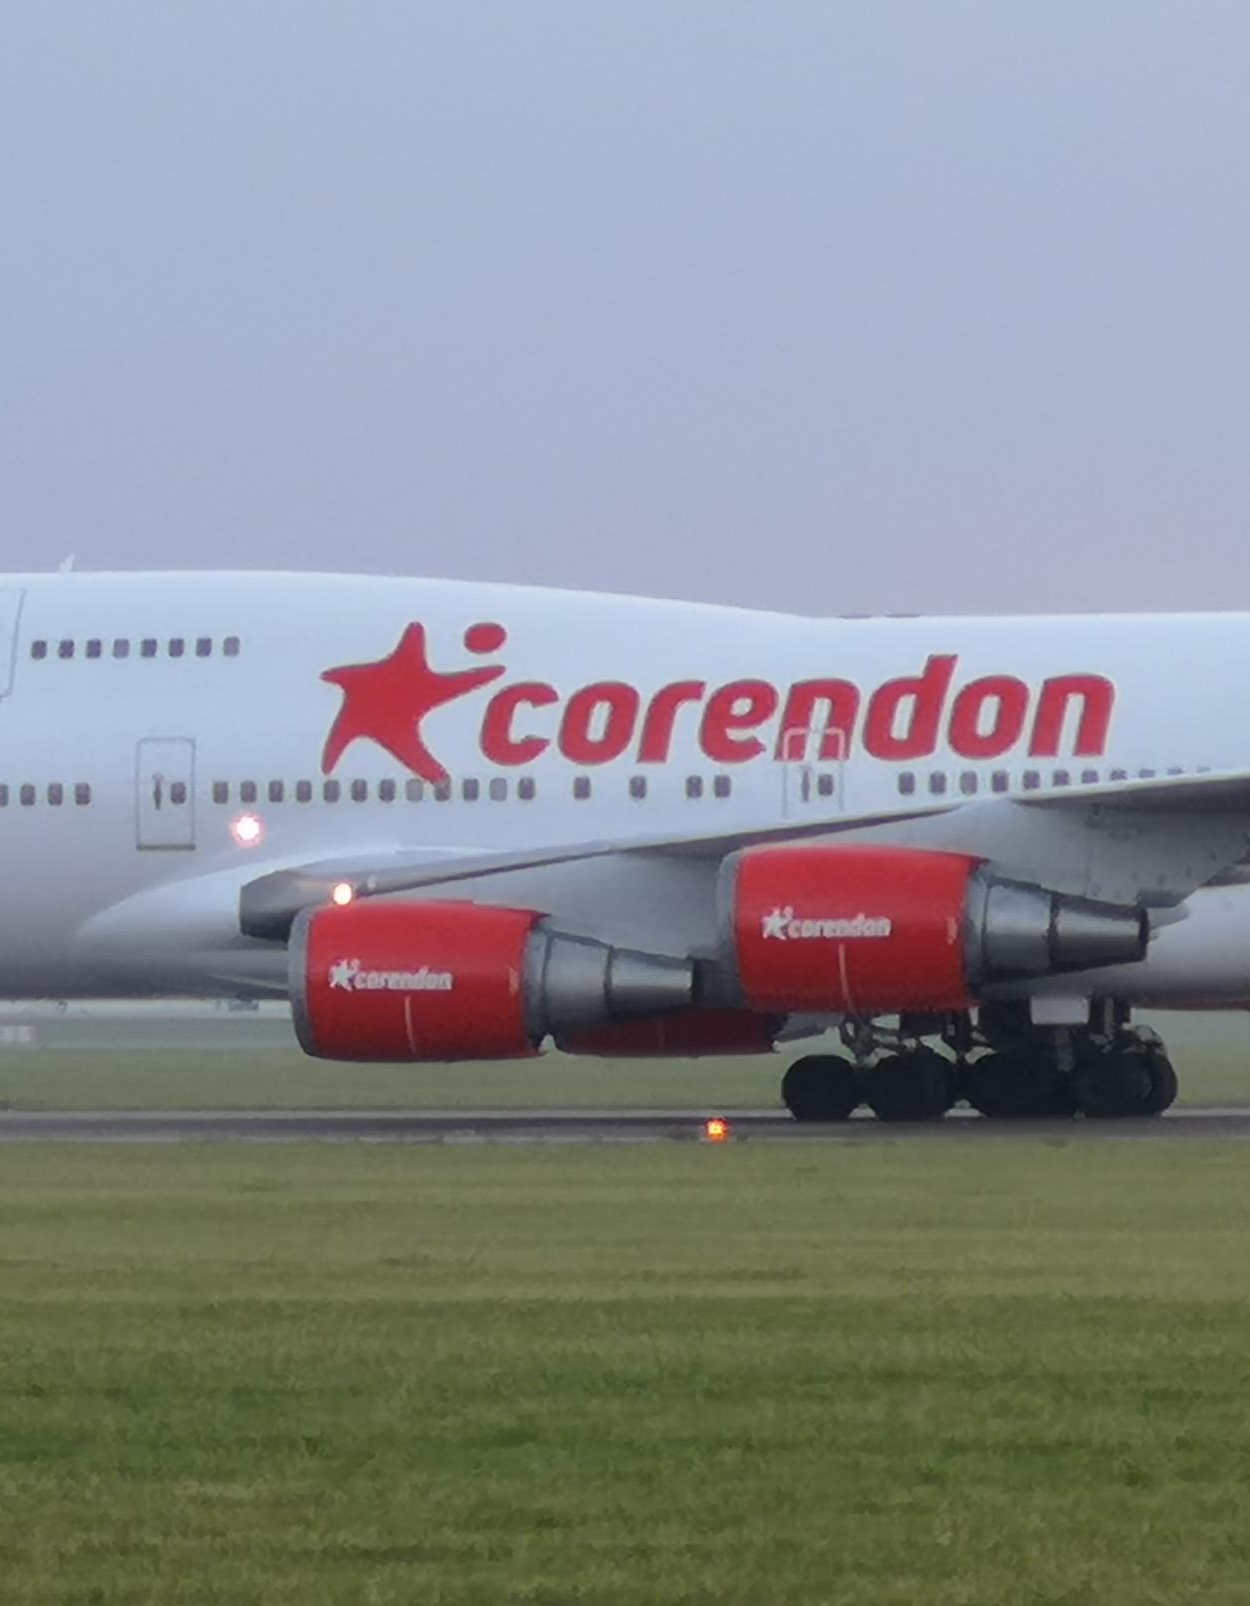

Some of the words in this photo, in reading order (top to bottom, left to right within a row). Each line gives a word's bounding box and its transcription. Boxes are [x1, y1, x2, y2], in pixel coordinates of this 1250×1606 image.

[478, 654, 1116, 766] corendon
[787, 913, 892, 939] corendon
[354, 965, 454, 990] corendon
